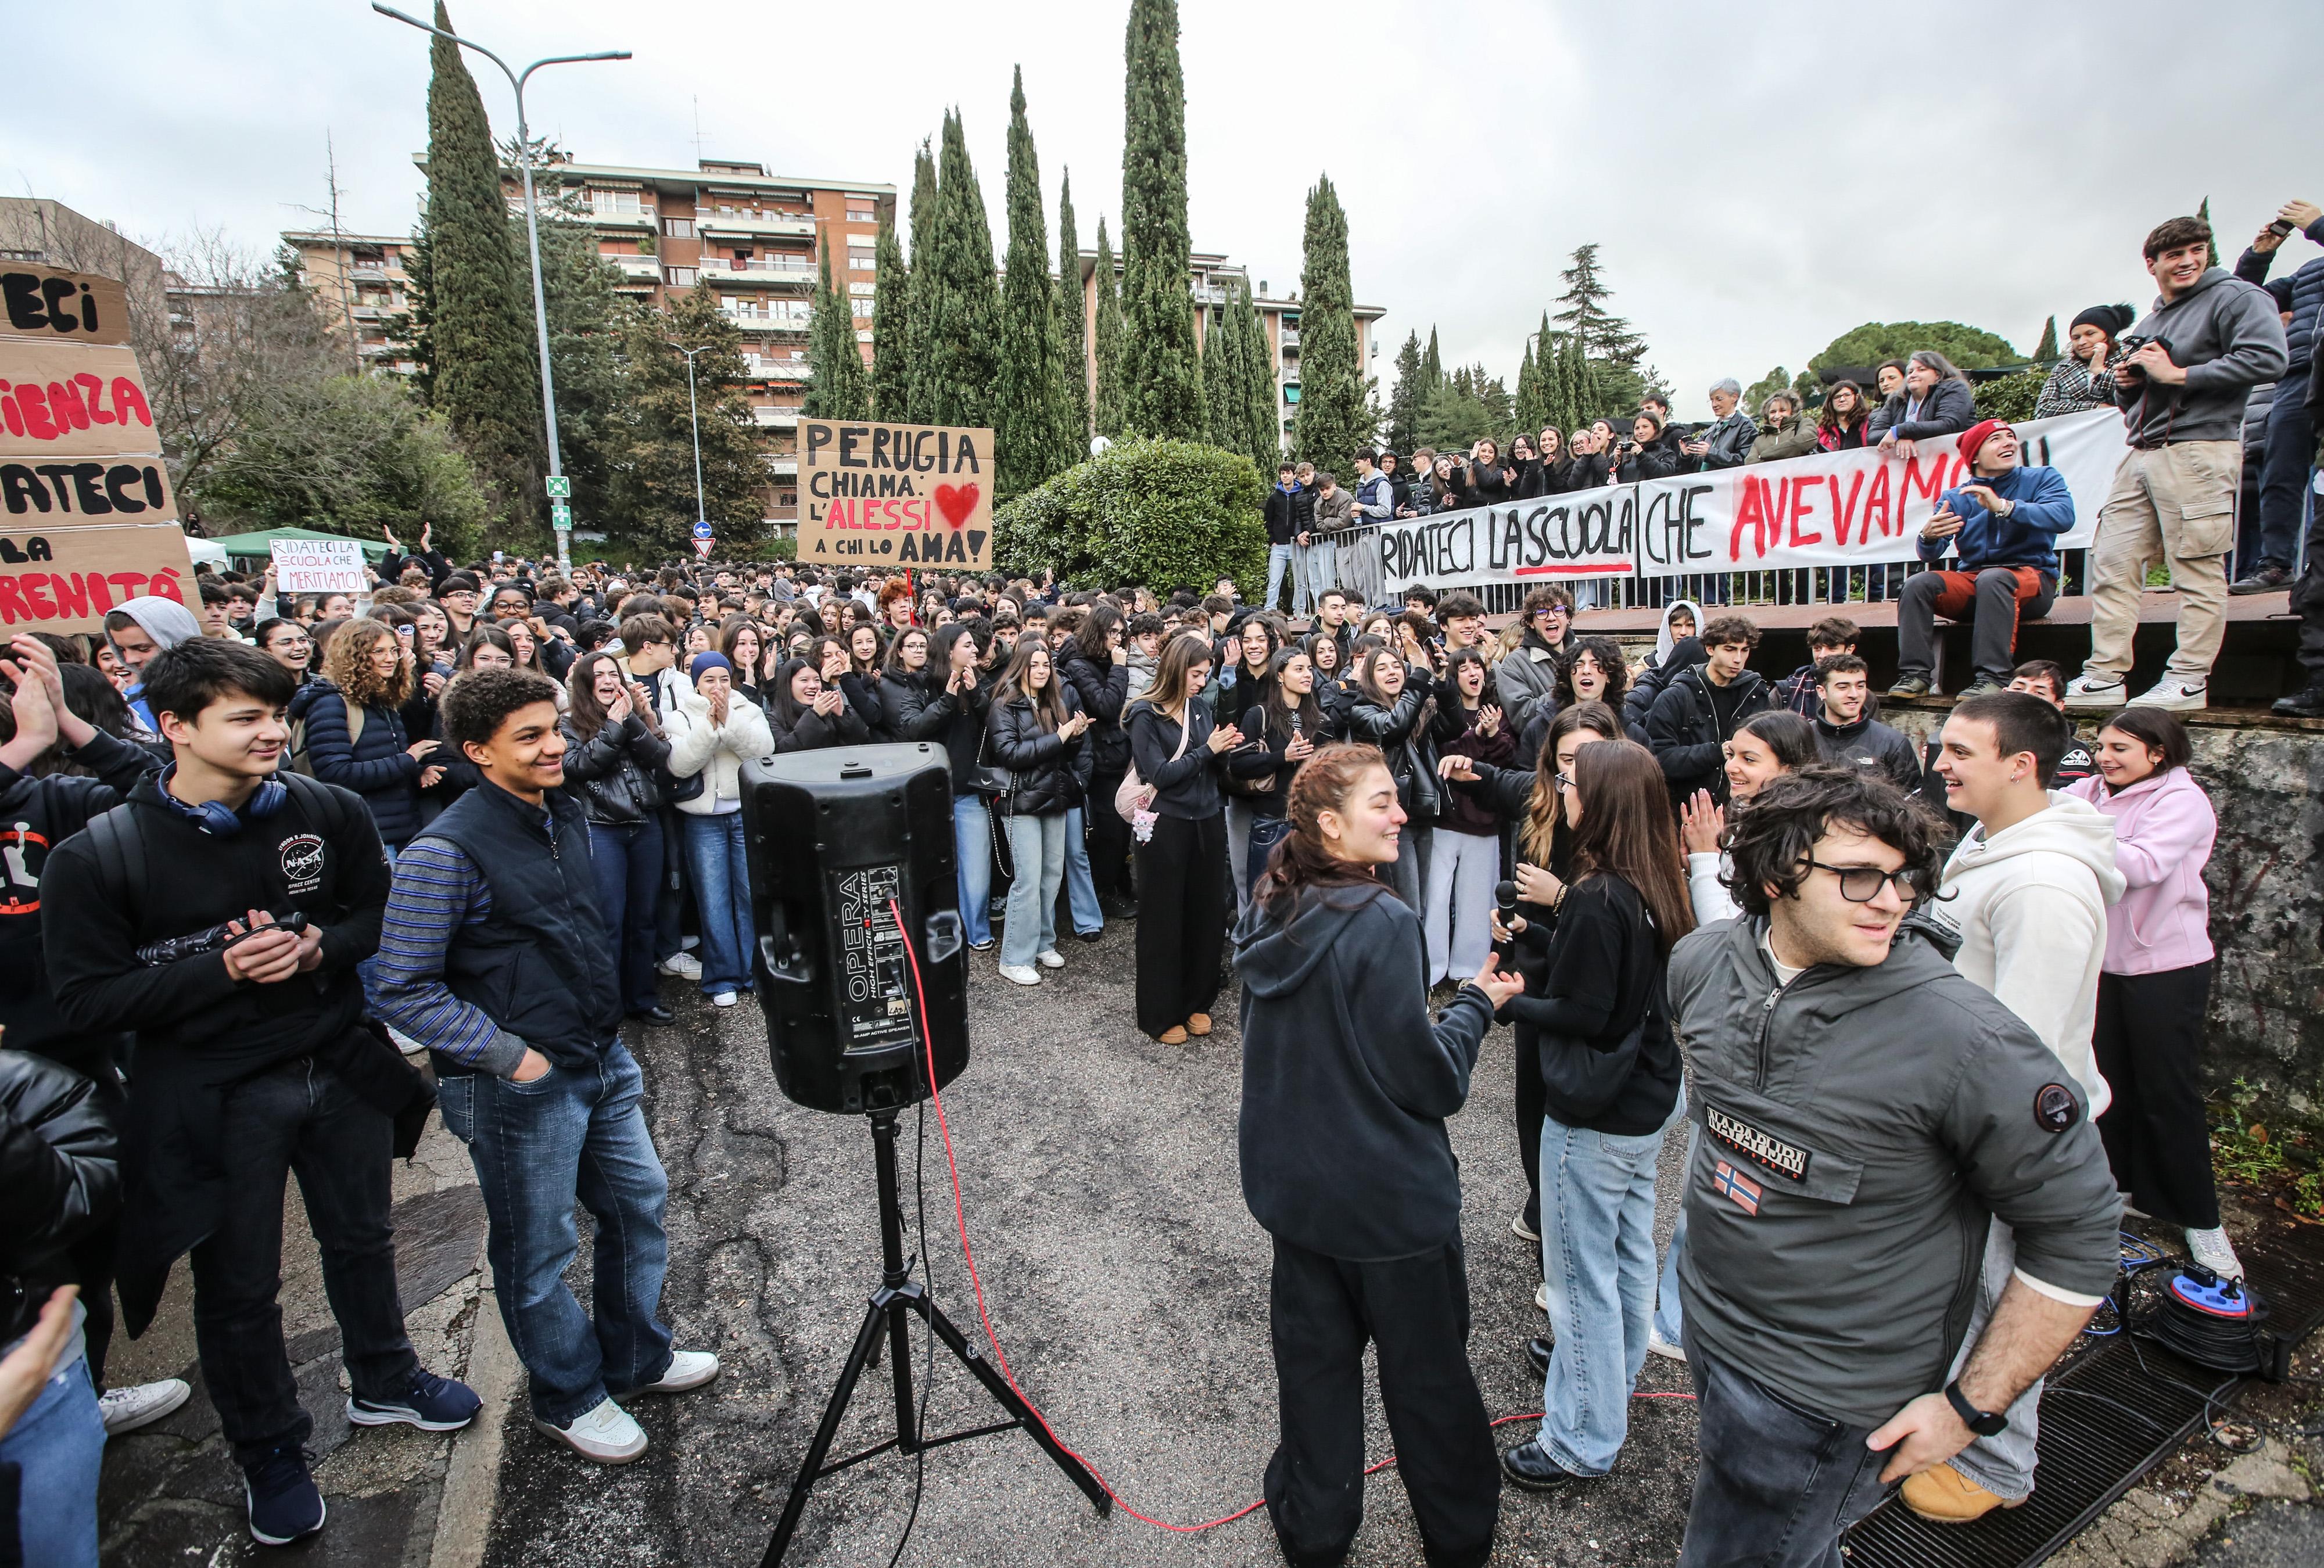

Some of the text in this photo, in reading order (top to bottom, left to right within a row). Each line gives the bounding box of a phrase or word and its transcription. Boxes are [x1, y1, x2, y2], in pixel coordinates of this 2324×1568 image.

[0, 272, 98, 332] ECi
[0, 373, 152, 440] iENZA
[807, 425, 979, 473] PERUGIA
[0, 463, 164, 515] ATECI
[810, 471, 924, 498] CHIAMA:
[810, 499, 931, 530] L'ALESSI
[272, 540, 354, 554] RIDATECI LA
[815, 530, 987, 563] A CHI LO AMA!
[1381, 518, 1473, 580] RIDATECI
[1645, 485, 1713, 564] CHE
[279, 555, 353, 566] SCUOLA CHE
[278, 837, 294, 851] LYNDON
[300, 834, 322, 842] JOHNSON
[286, 853, 321, 868] NASA
[304, 877, 320, 886] CENTER
[840, 872, 869, 1002] OPERA
[863, 906, 874, 967] EFFICIEY
